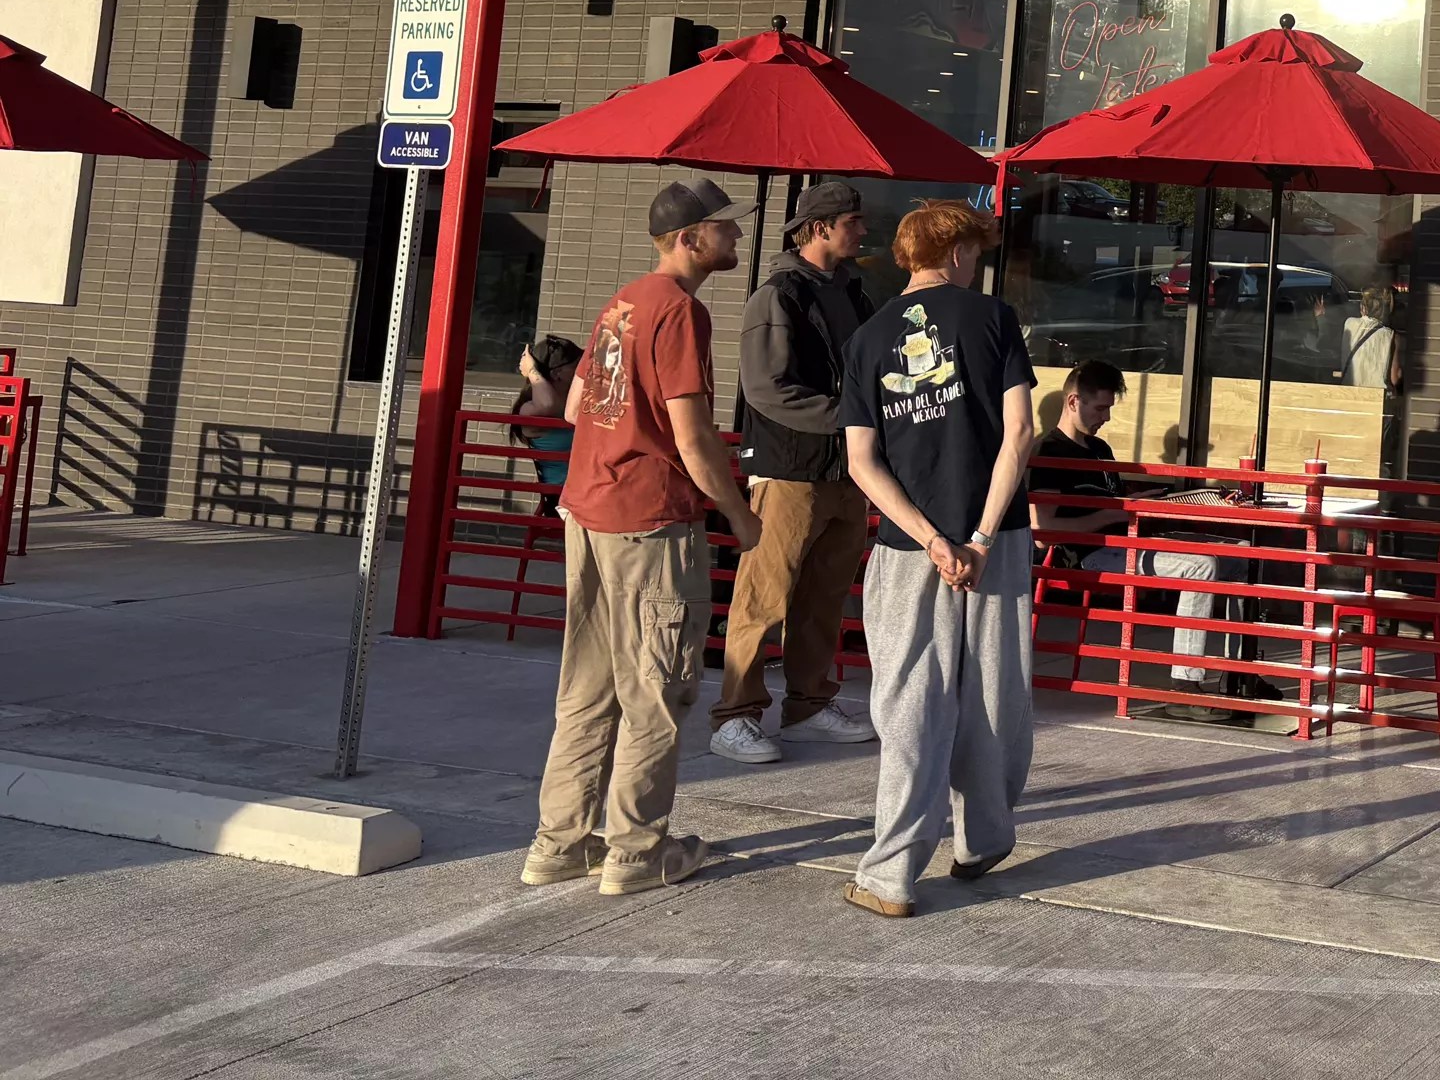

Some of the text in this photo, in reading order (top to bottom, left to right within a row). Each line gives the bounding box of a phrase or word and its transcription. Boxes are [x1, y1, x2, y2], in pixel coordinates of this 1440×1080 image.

[401, 22, 454, 40] PARKING
[1060, 1, 1167, 70] Open
[405, 130, 429, 146] VAN
[390, 147, 439, 158] ACCESSIBLE
[882, 398, 913, 420] PLAYA
[915, 392, 932, 410] DEL
[912, 405, 946, 424] MEXICO
